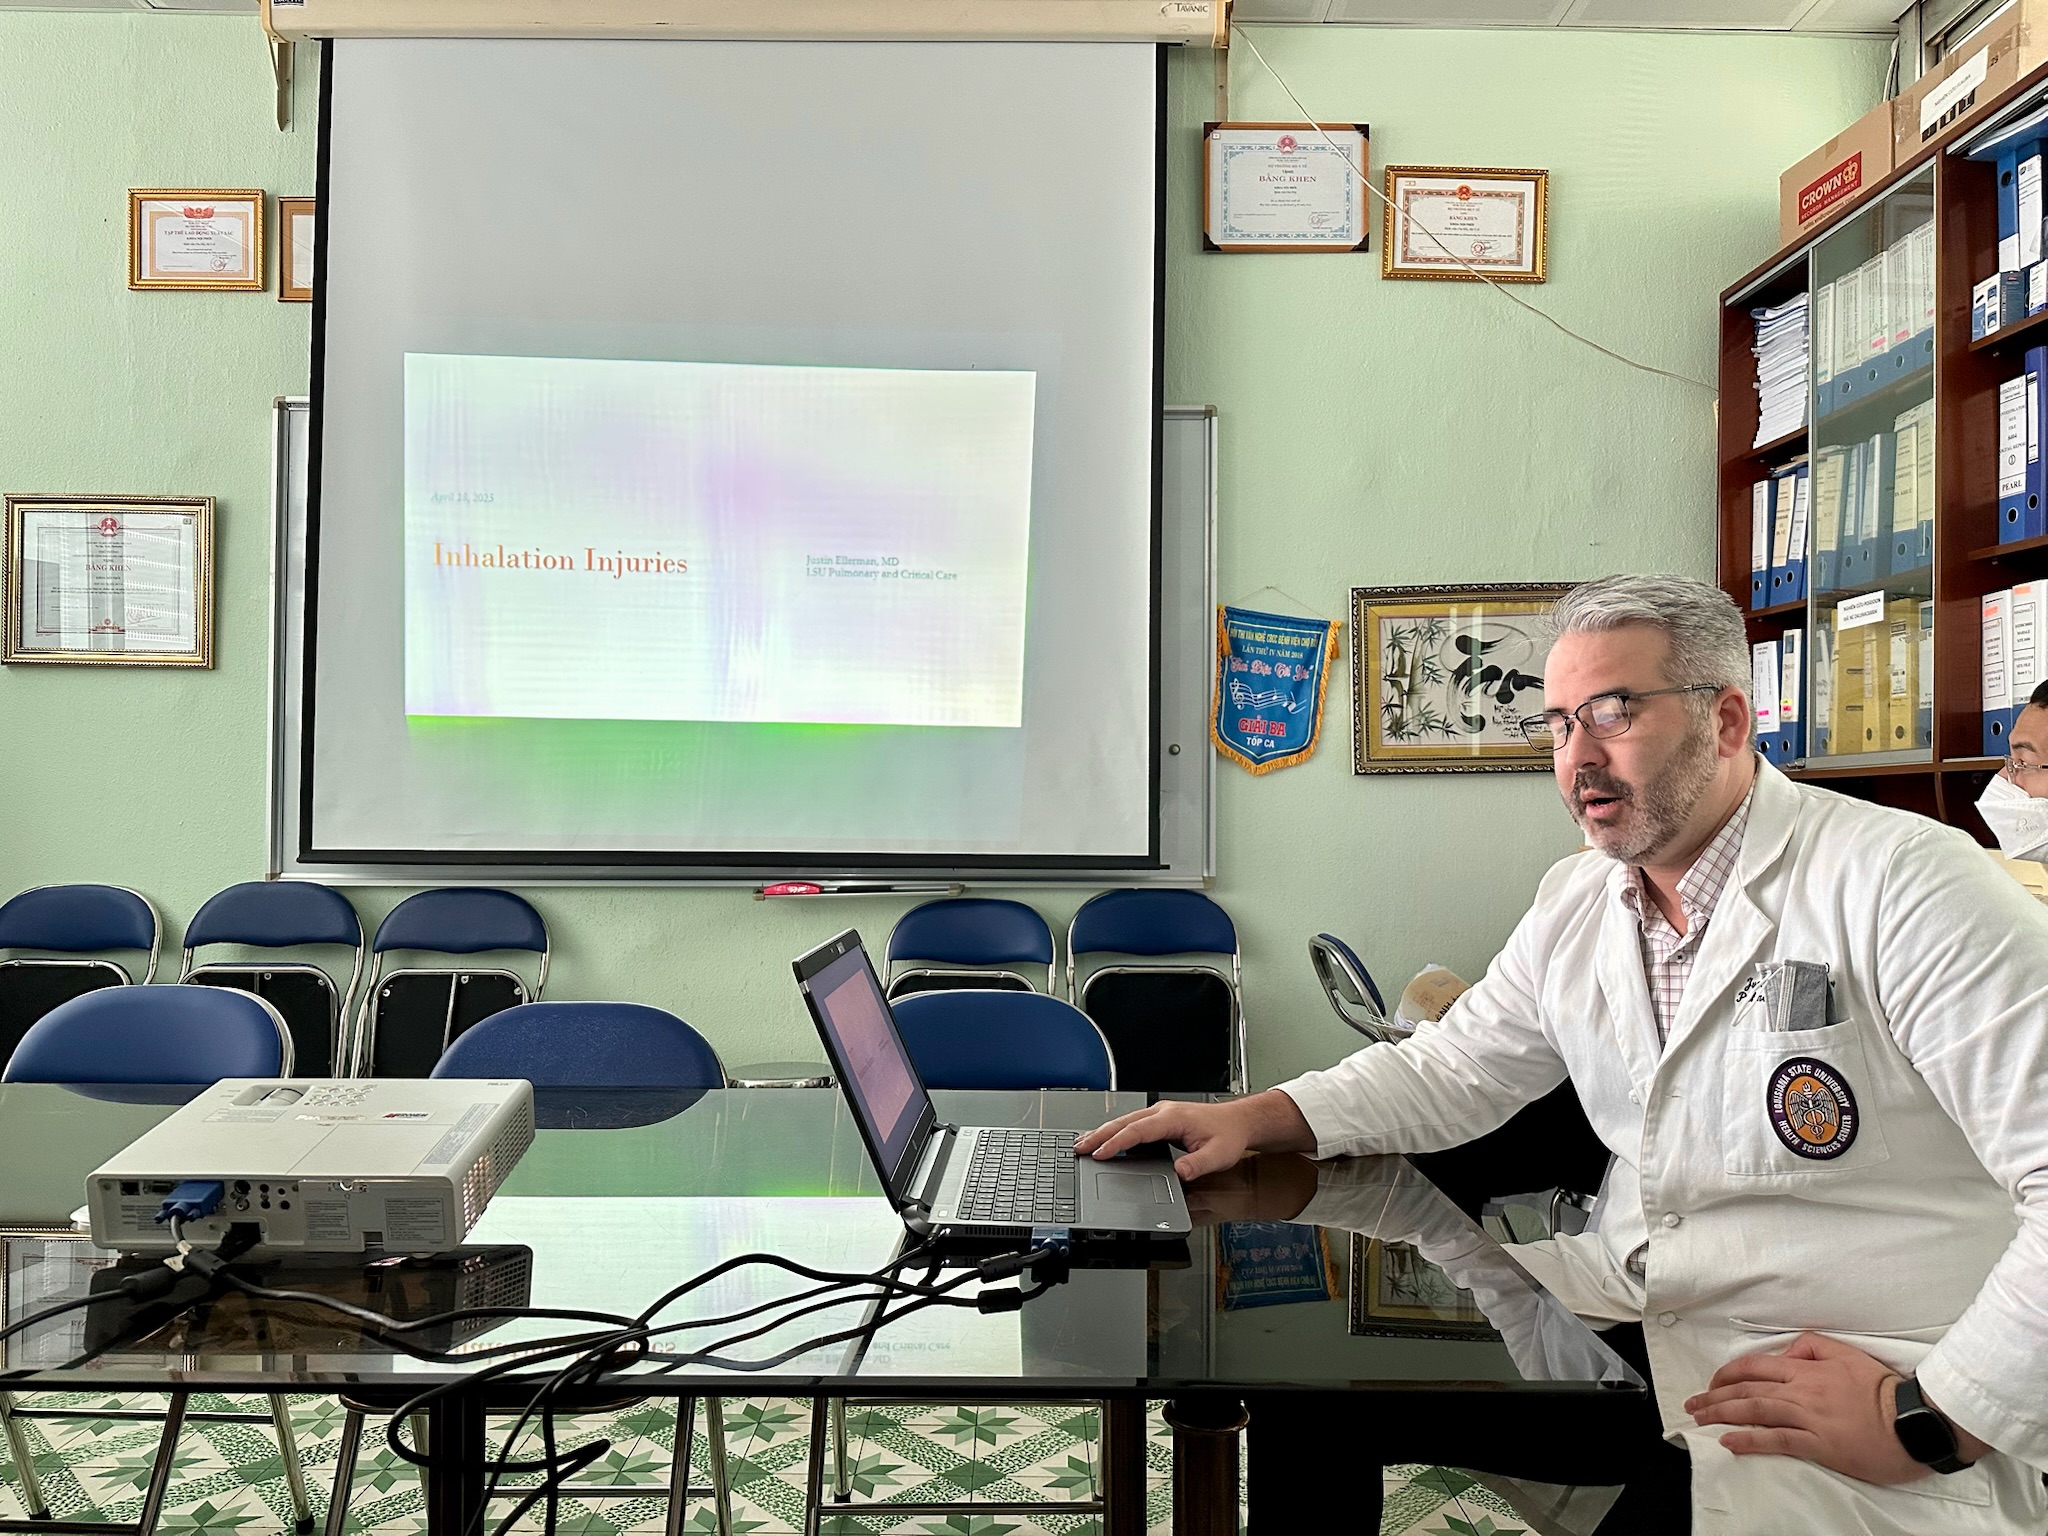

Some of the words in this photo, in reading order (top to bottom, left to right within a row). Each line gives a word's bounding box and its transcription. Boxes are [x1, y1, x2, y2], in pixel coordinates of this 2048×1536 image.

[1174, 2, 1208, 12] TAVANIC
[1259, 172, 1286, 183] BẰNG
[1289, 175, 1317, 183] KHEN
[1801, 172, 1843, 210] CROWN
[2001, 480, 2023, 492] PEARL
[433, 542, 576, 571] Inhalation
[584, 547, 689, 580] Injuries
[806, 555, 834, 566] Justin
[835, 555, 880, 567] Ellerman,
[881, 556, 900, 567] MD
[806, 567, 827, 578] LSU
[828, 567, 880, 581] Pulmonary
[881, 569, 899, 579] and
[900, 569, 934, 580] Critical
[935, 570, 958, 581] Care
[1269, 648, 1276, 656] IV
[1276, 648, 1291, 658] NĂM
[1238, 714, 1268, 735] GIẢI
[1268, 721, 1287, 737] BA
[1246, 735, 1263, 747] TỐP
[1263, 739, 1275, 748] CA
[1773, 1073, 1791, 1114] LOUISIANA
[1787, 1063, 1812, 1077] STATE
[1814, 1067, 1851, 1108] UNIVERSITY
[1778, 1119, 1801, 1146] HEALTH
[1801, 1140, 1842, 1154] SCIENCES
[1837, 1114, 1852, 1143] CENTER
